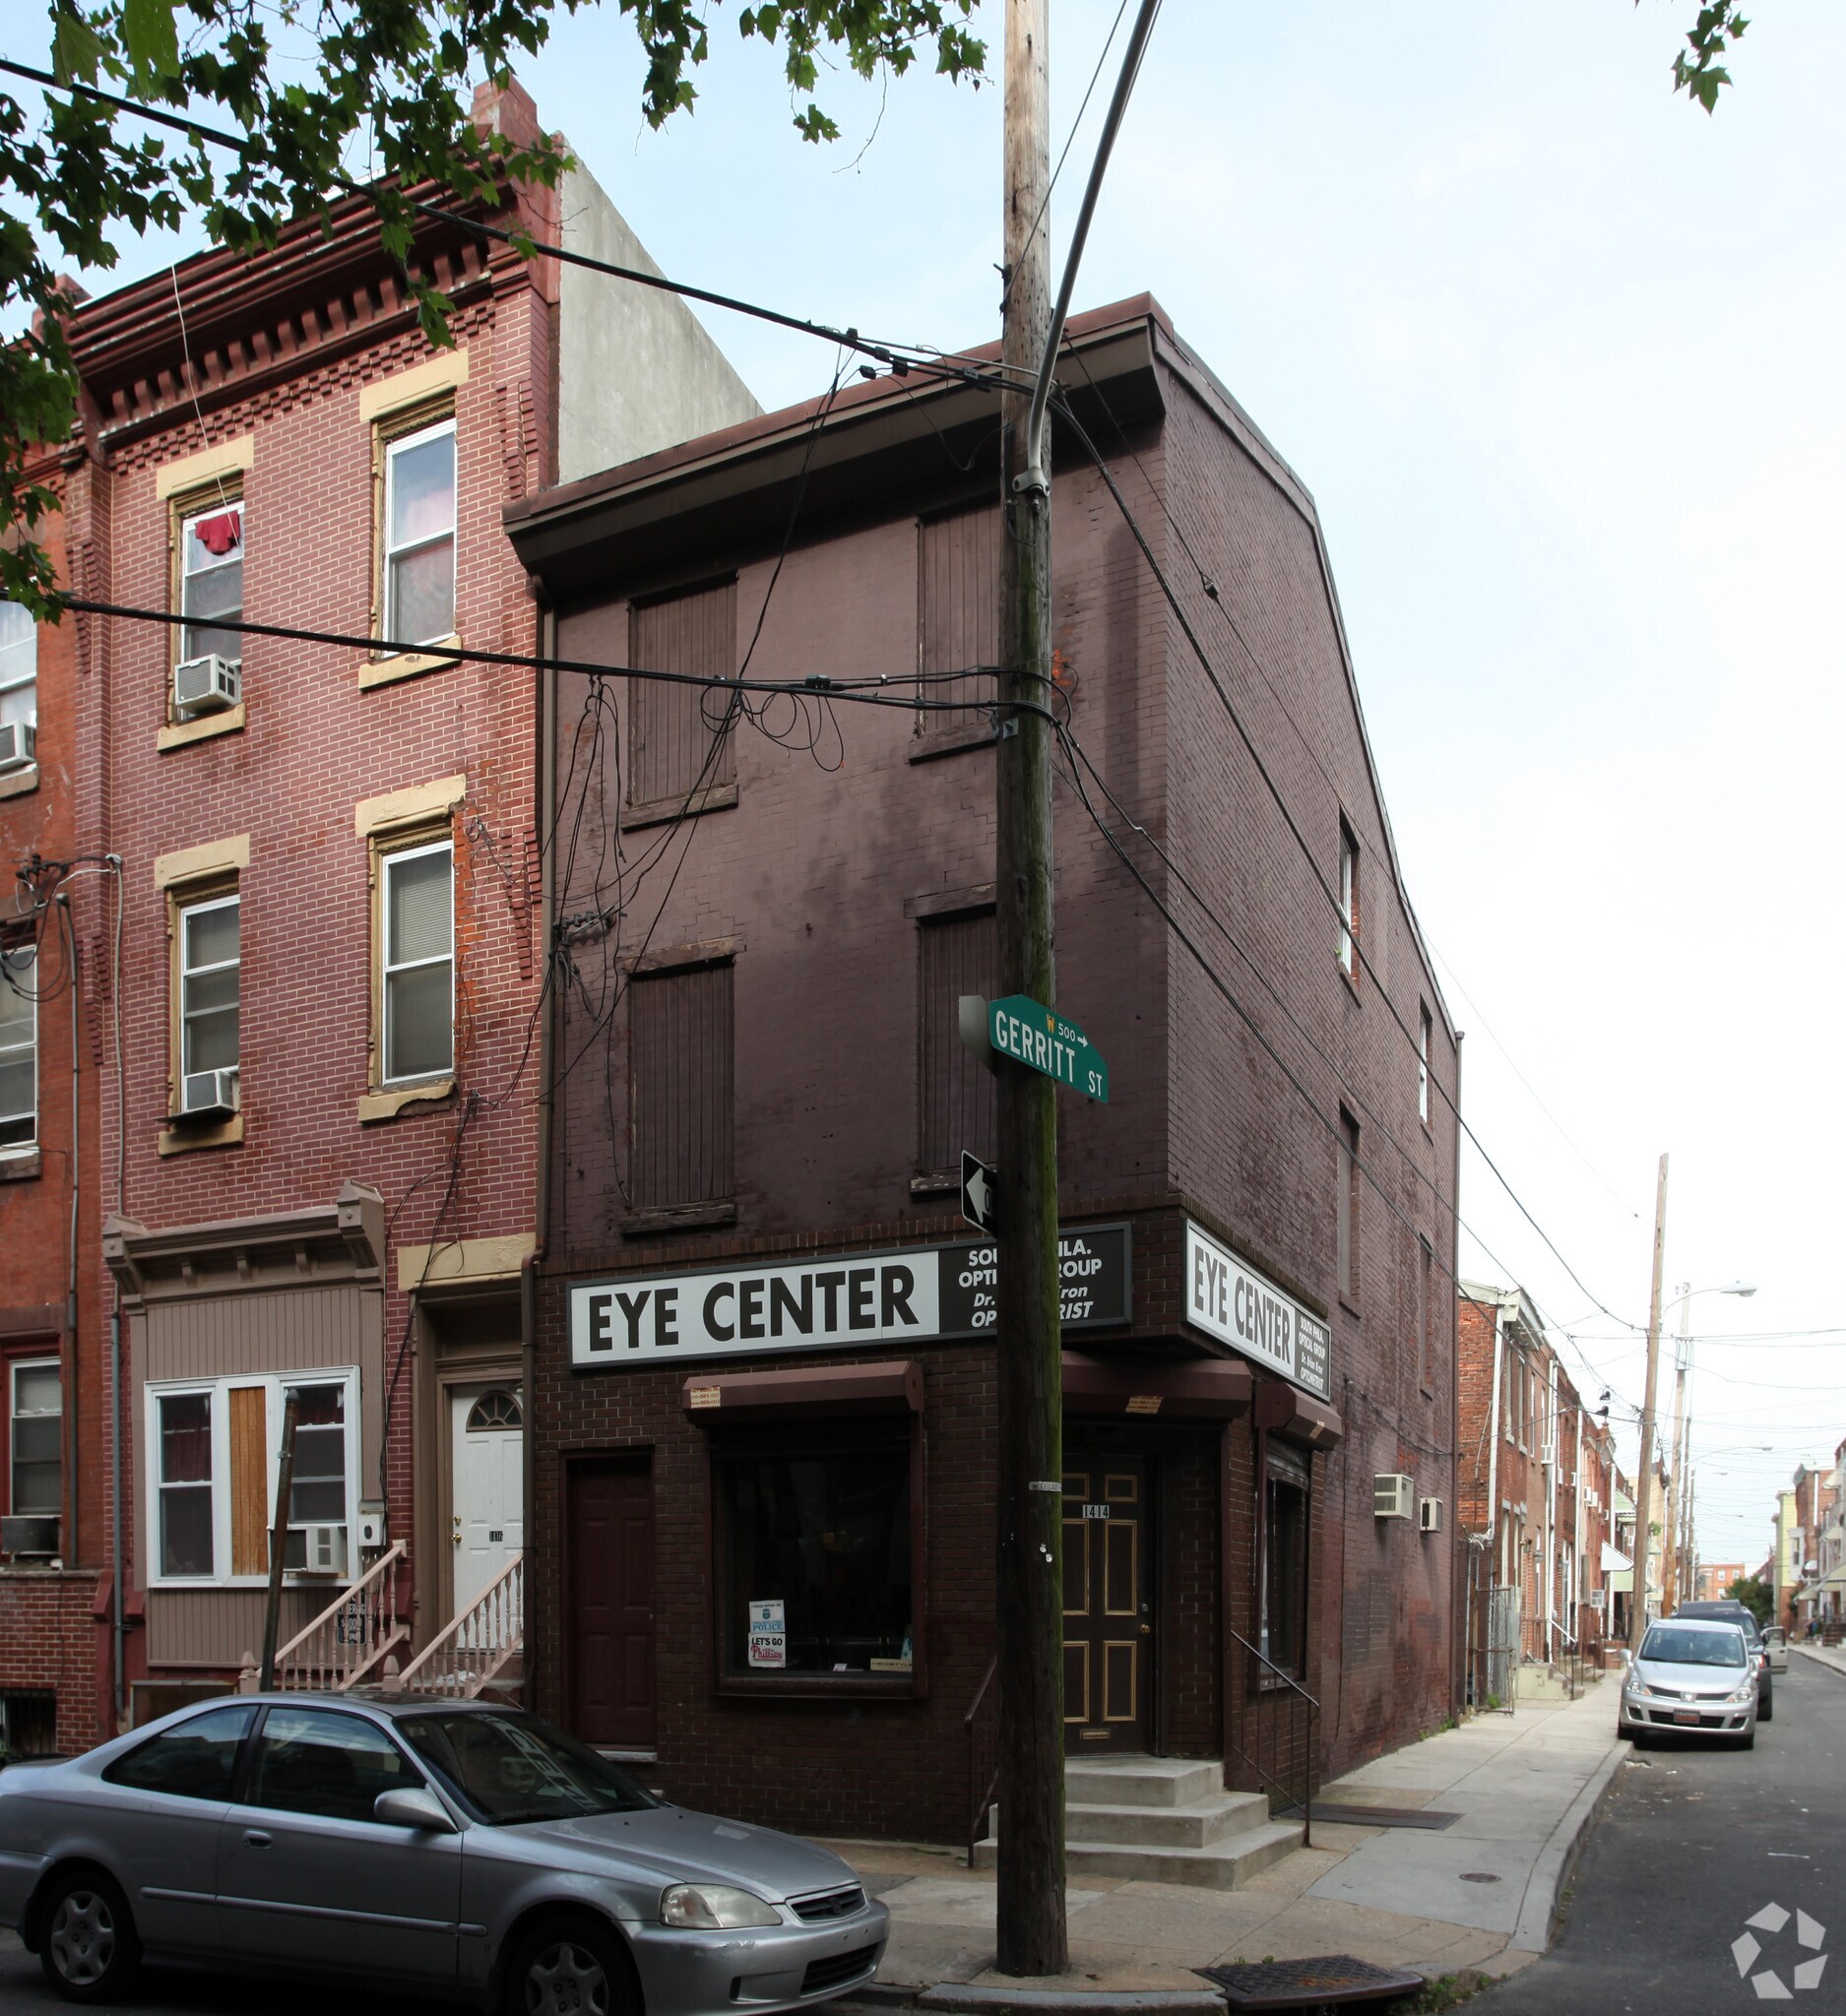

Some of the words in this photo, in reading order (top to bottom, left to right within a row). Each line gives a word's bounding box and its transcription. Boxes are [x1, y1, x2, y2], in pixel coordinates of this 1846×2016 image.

[1046, 1013, 1055, 1034] W
[1057, 1023, 1076, 1042] 500
[995, 1010, 1075, 1083] GERRITT
[1088, 1070, 1103, 1097] ST
[590, 1287, 679, 1353] EYE
[702, 1264, 920, 1343] CENTER
[974, 1292, 995, 1307] Dr.
[1058, 1286, 1088, 1299] ron
[1194, 1243, 1228, 1327] EYE
[1235, 1276, 1291, 1365] CENTER
[1085, 1505, 1109, 1518] 1414
[750, 1644, 783, 1659] Phillies
[751, 1637, 771, 1646] LET'S
[772, 1637, 783, 1646] GO
